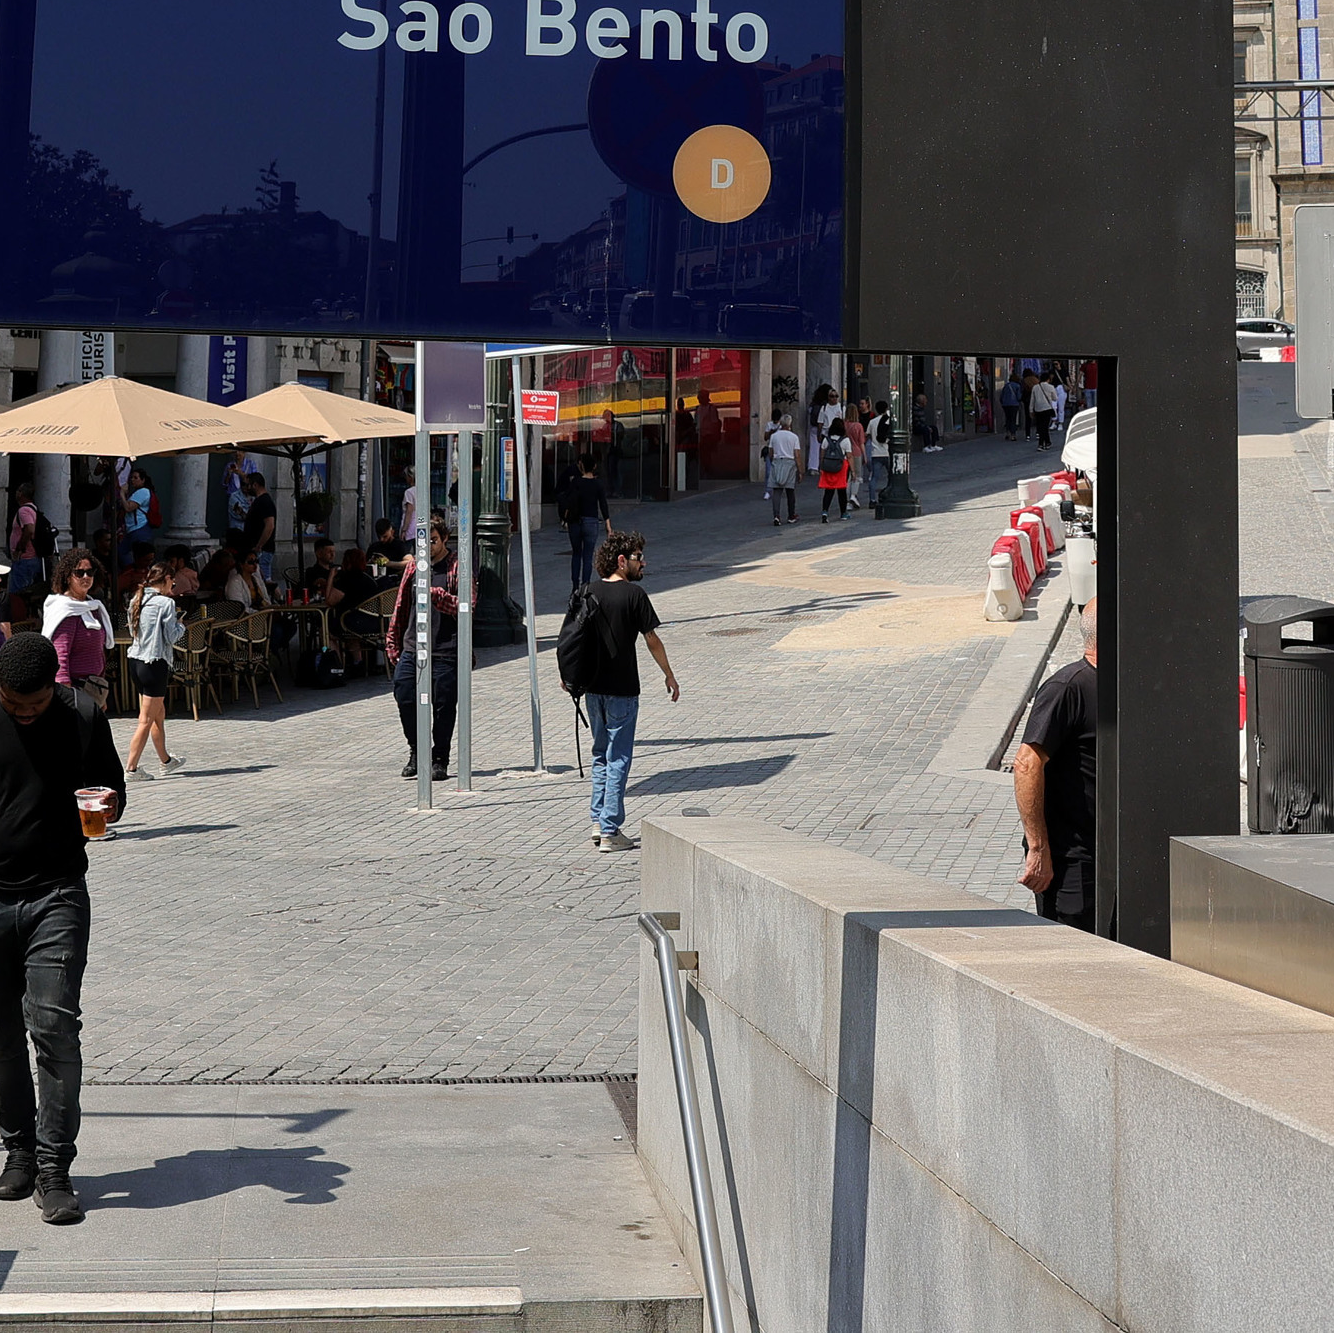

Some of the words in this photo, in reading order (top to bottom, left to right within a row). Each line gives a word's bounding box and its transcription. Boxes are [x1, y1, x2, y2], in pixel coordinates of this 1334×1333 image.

[711, 158, 734, 189] D
[222, 350, 236, 395] Visit
[17, 424, 80, 436] TRAVELLER
